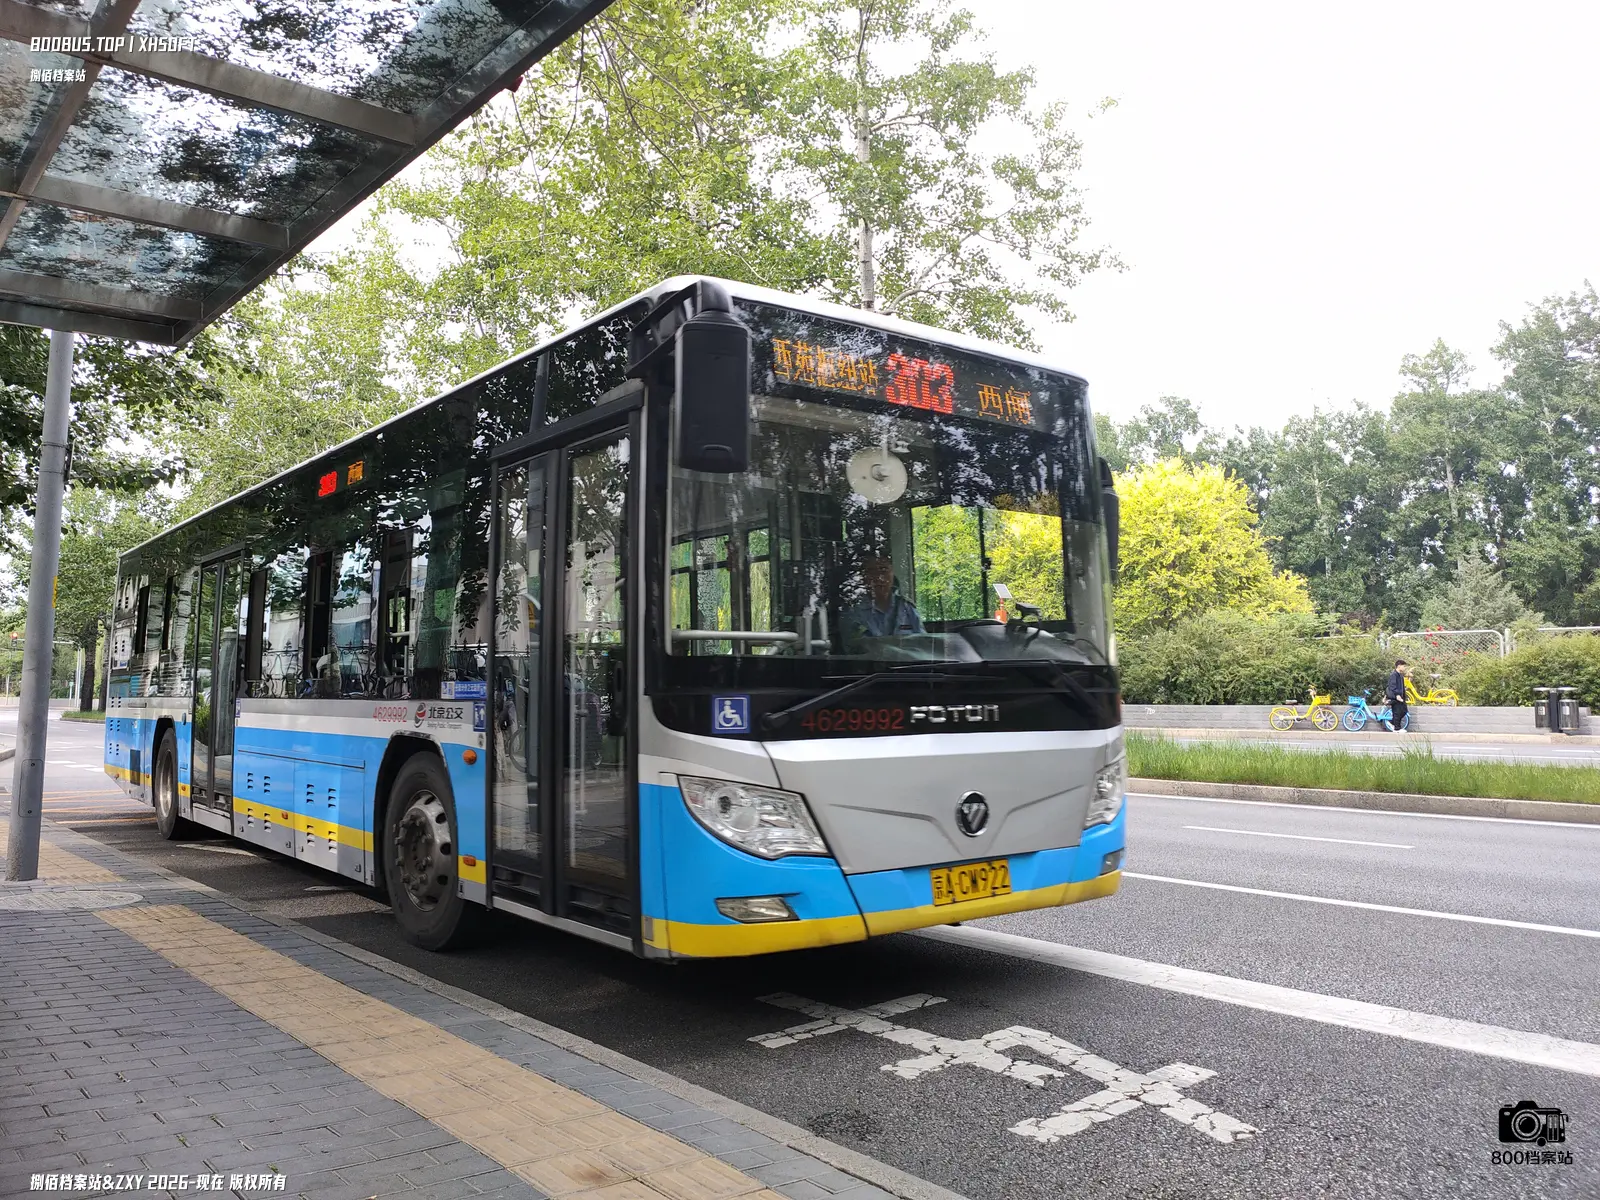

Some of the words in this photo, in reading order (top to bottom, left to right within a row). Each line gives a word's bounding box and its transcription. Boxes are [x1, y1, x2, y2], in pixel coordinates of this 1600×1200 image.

[885, 352, 954, 415] 303
[372, 706, 408, 722] 4629992
[428, 706, 464, 719] 北京公交
[801, 708, 905, 731] 4629992
[910, 704, 1000, 723] FOTON
